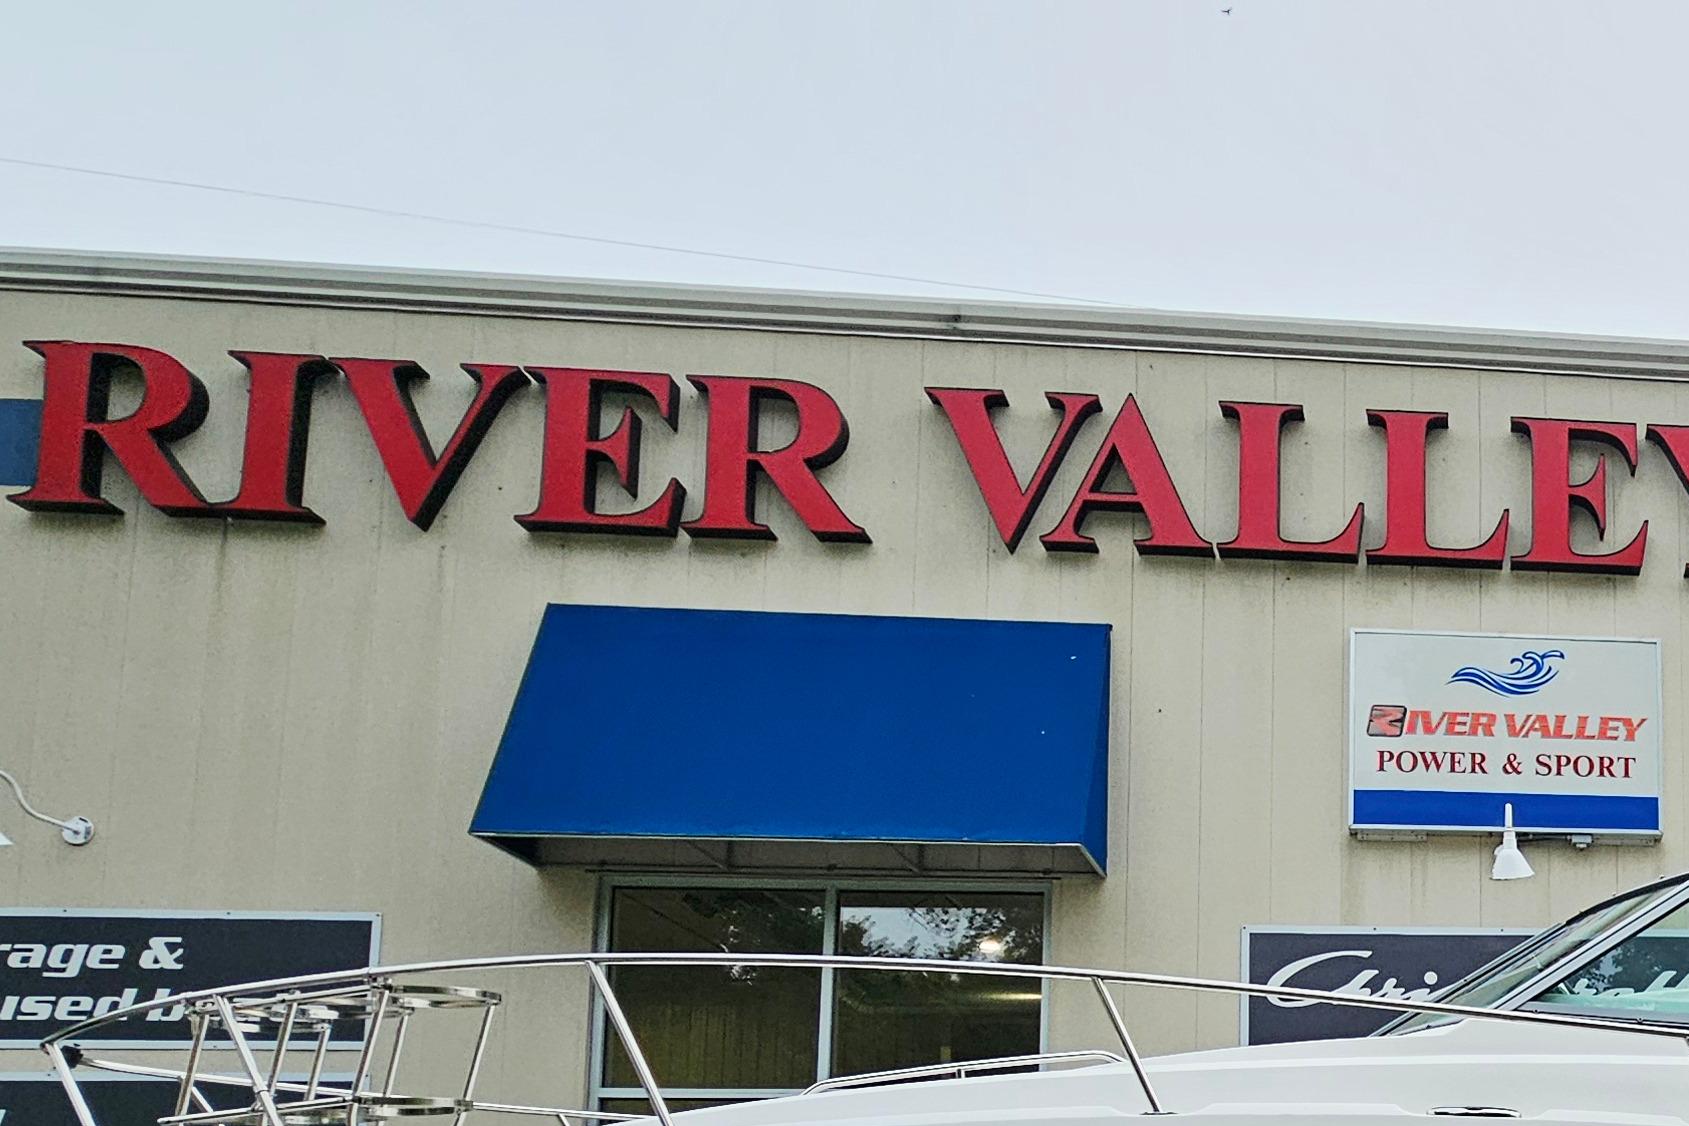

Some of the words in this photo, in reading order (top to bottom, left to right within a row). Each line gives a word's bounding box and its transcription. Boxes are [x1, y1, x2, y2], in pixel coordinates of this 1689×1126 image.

[6, 340, 874, 544] RIVER
[1367, 704, 1497, 738] RIVER
[1503, 713, 1648, 742] VALLEY
[1376, 750, 1488, 775] POWER
[1502, 752, 1523, 775] &
[1535, 753, 1636, 779] SPORT
[139, 937, 184, 969] &
